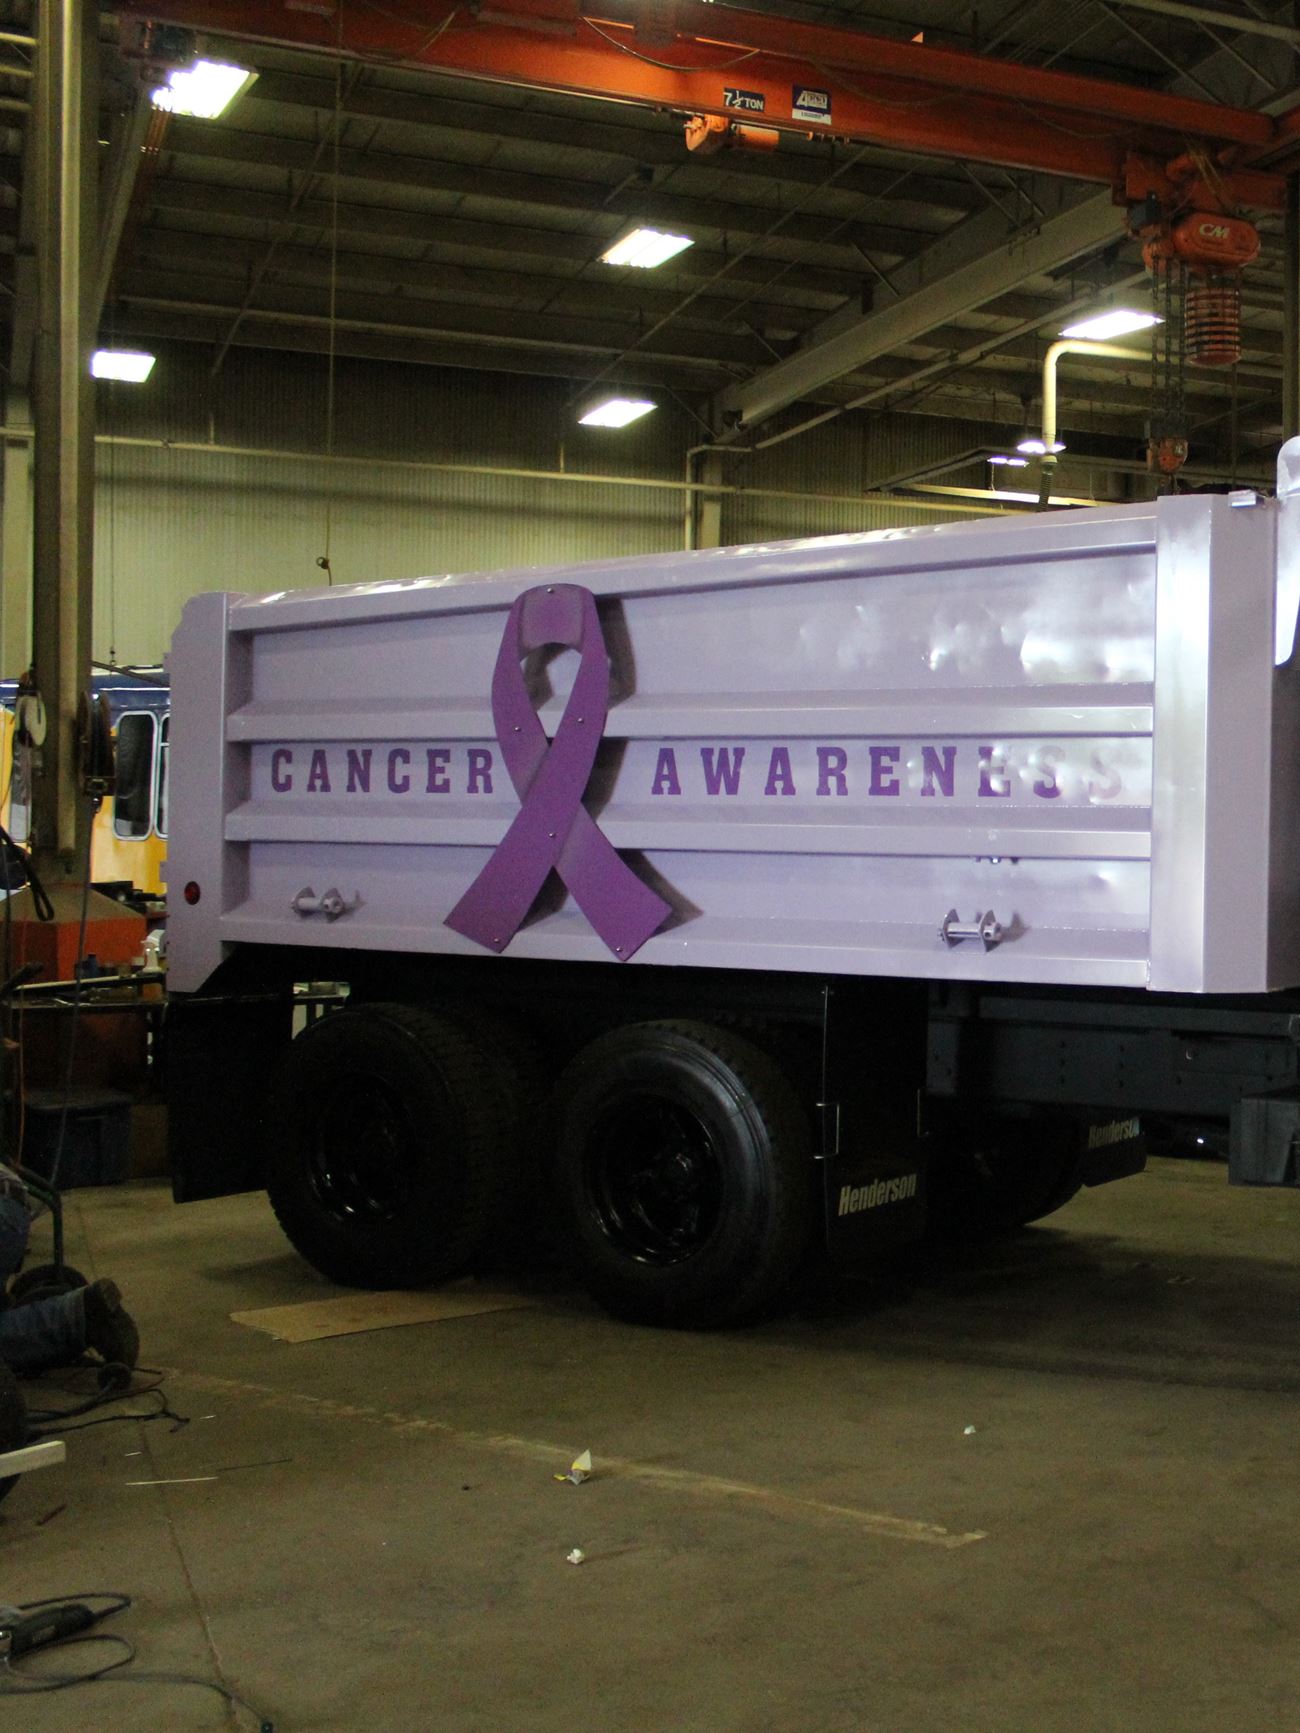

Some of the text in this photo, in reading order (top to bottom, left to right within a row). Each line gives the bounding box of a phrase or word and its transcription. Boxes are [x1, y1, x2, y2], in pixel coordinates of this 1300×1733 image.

[745, 97, 764, 110] TON
[1199, 223, 1231, 239] CM
[271, 745, 1123, 799] CANCER AWARENESS
[838, 1173, 918, 1217] Henderson
